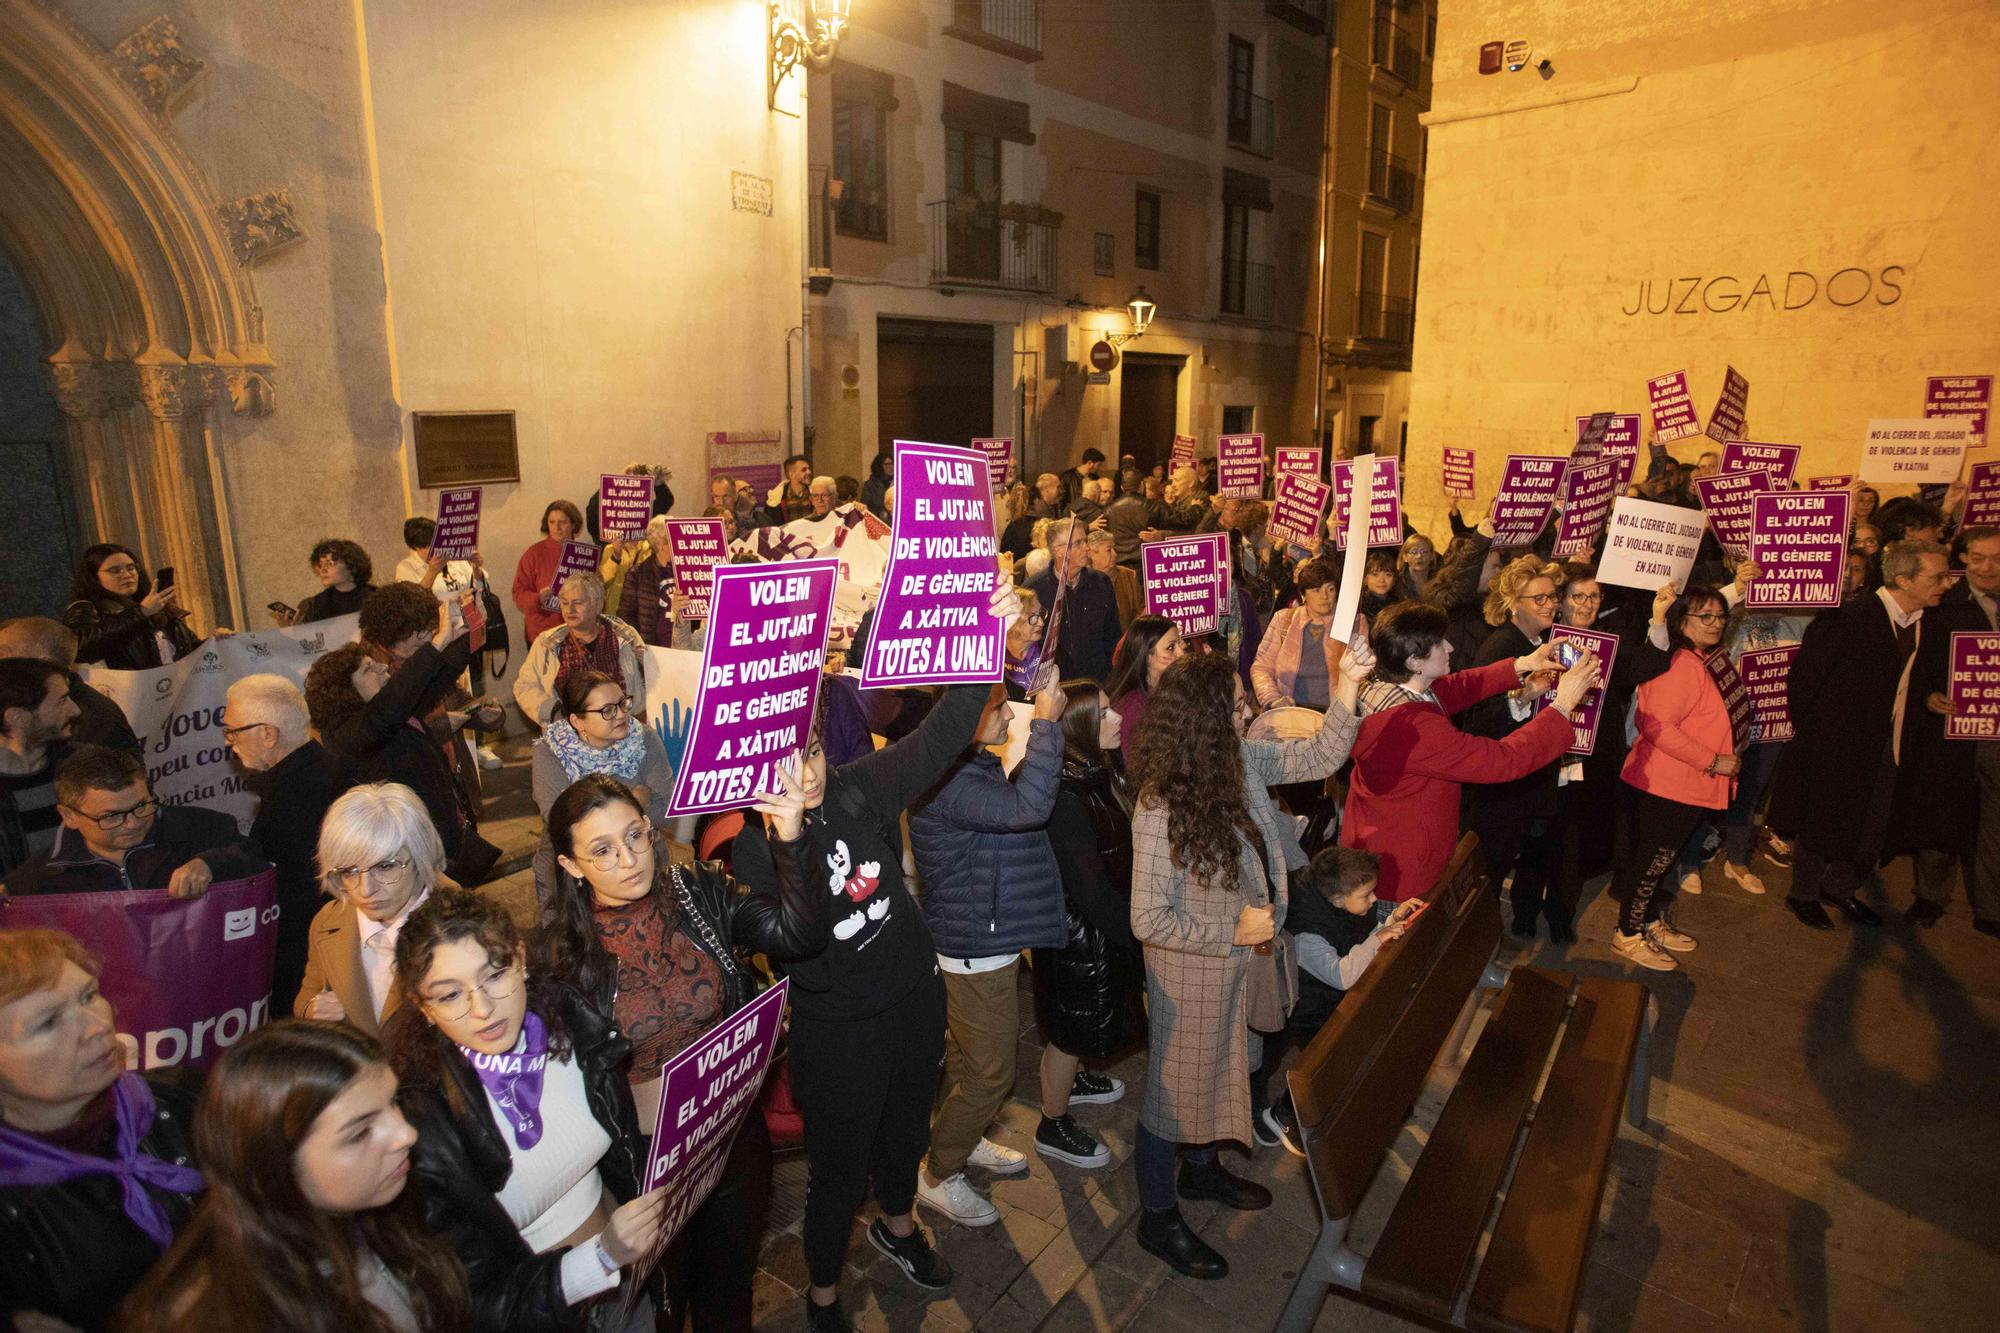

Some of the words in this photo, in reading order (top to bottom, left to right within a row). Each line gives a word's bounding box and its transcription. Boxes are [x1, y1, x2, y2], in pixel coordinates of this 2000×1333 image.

[1622, 265, 1905, 316] JUZGADOS
[1655, 376, 1677, 388] VOLEM
[1653, 391, 1660, 399] EL
[1661, 384, 1682, 396] JUTJAT
[1661, 420, 1666, 428] A
[1657, 427, 1678, 442] TOTES
[1678, 425, 1683, 437] A
[1871, 431, 1880, 440] NO
[1881, 431, 1891, 440] AL
[1892, 430, 1917, 440] CIERRE
[1918, 431, 1931, 440] DEL
[1932, 431, 1966, 440] JUZGADO
[1229, 438, 1253, 446] VOLEM
[1286, 452, 1310, 460] VOLEM
[1742, 447, 1781, 458] VOLEM
[1869, 447, 1879, 455] DE
[1881, 447, 1917, 455] VIOLENCIA
[1921, 447, 1930, 455] DE
[1521, 461, 1554, 472] VOLEM
[1731, 460, 1743, 469] EL
[1893, 463, 1902, 471] EN
[925, 460, 974, 486] VOLEM
[1583, 465, 1610, 480] VOLEM
[614, 479, 640, 487] VOLEM
[1294, 479, 1318, 493] VOLEM
[1511, 477, 1521, 486] EL
[1523, 478, 1554, 487] JUTJAT
[1576, 486, 1585, 496] EL
[1587, 478, 1612, 493] JUTJAT
[1712, 477, 1751, 490] VOLEM
[1222, 487, 1240, 498] TOTES
[1241, 487, 1245, 496] A
[1286, 487, 1294, 495] EL
[1295, 490, 1319, 504] JUTJAT
[1337, 493, 1348, 502] DE
[1500, 492, 1512, 502] DE
[1514, 491, 1554, 502] VIOLÈNCIA
[1710, 495, 1723, 503] EL
[613, 500, 650, 508] VIOLÈNCIA
[915, 498, 934, 520] EL
[938, 500, 985, 520] JUTJAT
[1566, 501, 1577, 511] DE
[1776, 498, 1825, 510] VOLEM
[1279, 507, 1288, 515] DE
[1501, 508, 1513, 517] DE
[1514, 507, 1545, 517] GÈNERE
[1707, 508, 1719, 516] DE
[1570, 514, 1580, 524] DE
[1717, 521, 1729, 529] DE
[1766, 516, 1782, 527] EL
[1785, 515, 1833, 527] JUTJAT
[680, 524, 711, 535] VOLEM
[1273, 523, 1291, 539] TOTES
[1292, 530, 1297, 542] A
[1571, 528, 1577, 537] A
[1617, 513, 1629, 526] NO
[1629, 515, 1639, 528] AL
[1640, 518, 1666, 532] CIERRE
[1665, 521, 1676, 535] DEL
[1678, 525, 1702, 539] JUZGADO
[604, 528, 624, 540] TOTES
[1370, 529, 1375, 543] A
[1377, 528, 1397, 542] UNA!
[1726, 533, 1733, 541] A
[1755, 534, 1771, 544] DE
[1774, 532, 1842, 544] VIOLÈNCIA
[678, 540, 688, 550] EL
[690, 540, 718, 550] JUTJAT
[896, 538, 920, 560] DE
[925, 532, 997, 559] VIOLÈNCIA
[1161, 545, 1199, 558] VOLEM
[1613, 535, 1624, 547] DE
[1626, 537, 1663, 554] VIOLENCIA
[1665, 544, 1674, 556] DE
[674, 556, 684, 565] DE
[686, 554, 727, 565] VIOLÈNCIA
[1762, 552, 1778, 562] DE
[1781, 549, 1832, 562] GÈNERE
[1155, 563, 1167, 573] EL
[1170, 559, 1206, 572] JUTJAT
[1635, 561, 1645, 572] EN
[1766, 569, 1775, 579] A
[1778, 566, 1823, 579] XÀTIVA
[681, 571, 692, 581] DE
[900, 576, 926, 595] DE
[929, 569, 994, 594] GÈNERE
[1149, 580, 1161, 589] DE
[1163, 574, 1215, 588] VIOLÈNCIA
[688, 587, 694, 596] A
[750, 576, 811, 606] VOLEM
[1155, 594, 1168, 604] DE
[1171, 589, 1209, 602] GÈNERE
[1754, 584, 1791, 602] TOTES
[1792, 584, 1801, 601] A
[1804, 583, 1834, 601] UNA!
[899, 610, 913, 630] A
[917, 604, 978, 628] XÀTIVA
[1162, 609, 1168, 618] A
[1171, 605, 1205, 618] XÀTIVA
[730, 623, 753, 646] EL
[757, 613, 817, 643] JUTJAT
[1185, 619, 1191, 634] A
[1193, 615, 1213, 632] UNA!
[1568, 634, 1601, 652] VOLEM
[876, 638, 931, 676] TOTES
[933, 636, 946, 673] A
[951, 635, 995, 671] UNA!
[1755, 652, 1788, 665] VOLEM
[1966, 655, 1983, 665] EL
[707, 663, 735, 689] DE
[740, 649, 822, 684] VIOLÈNCIA
[1749, 671, 1759, 680] EL
[1954, 671, 1972, 682] DE
[1962, 688, 1980, 698] DE
[714, 701, 742, 725] DE
[746, 687, 809, 721] GÈNERE
[1967, 704, 1976, 713] A
[1763, 724, 1770, 738] A
[1954, 717, 1995, 735] TOTES
[716, 740, 732, 761] A
[736, 726, 797, 757] XÀTIVA
[687, 766, 753, 805] TOTES
[697, 1014, 760, 1079] VOLEM
[475, 1053, 522, 1073] UNA
[677, 1095, 698, 1129] EL
[703, 1043, 763, 1107] JUTJAT
[654, 1143, 681, 1182] DE
[685, 1067, 764, 1154] VIOLÈNCIA
